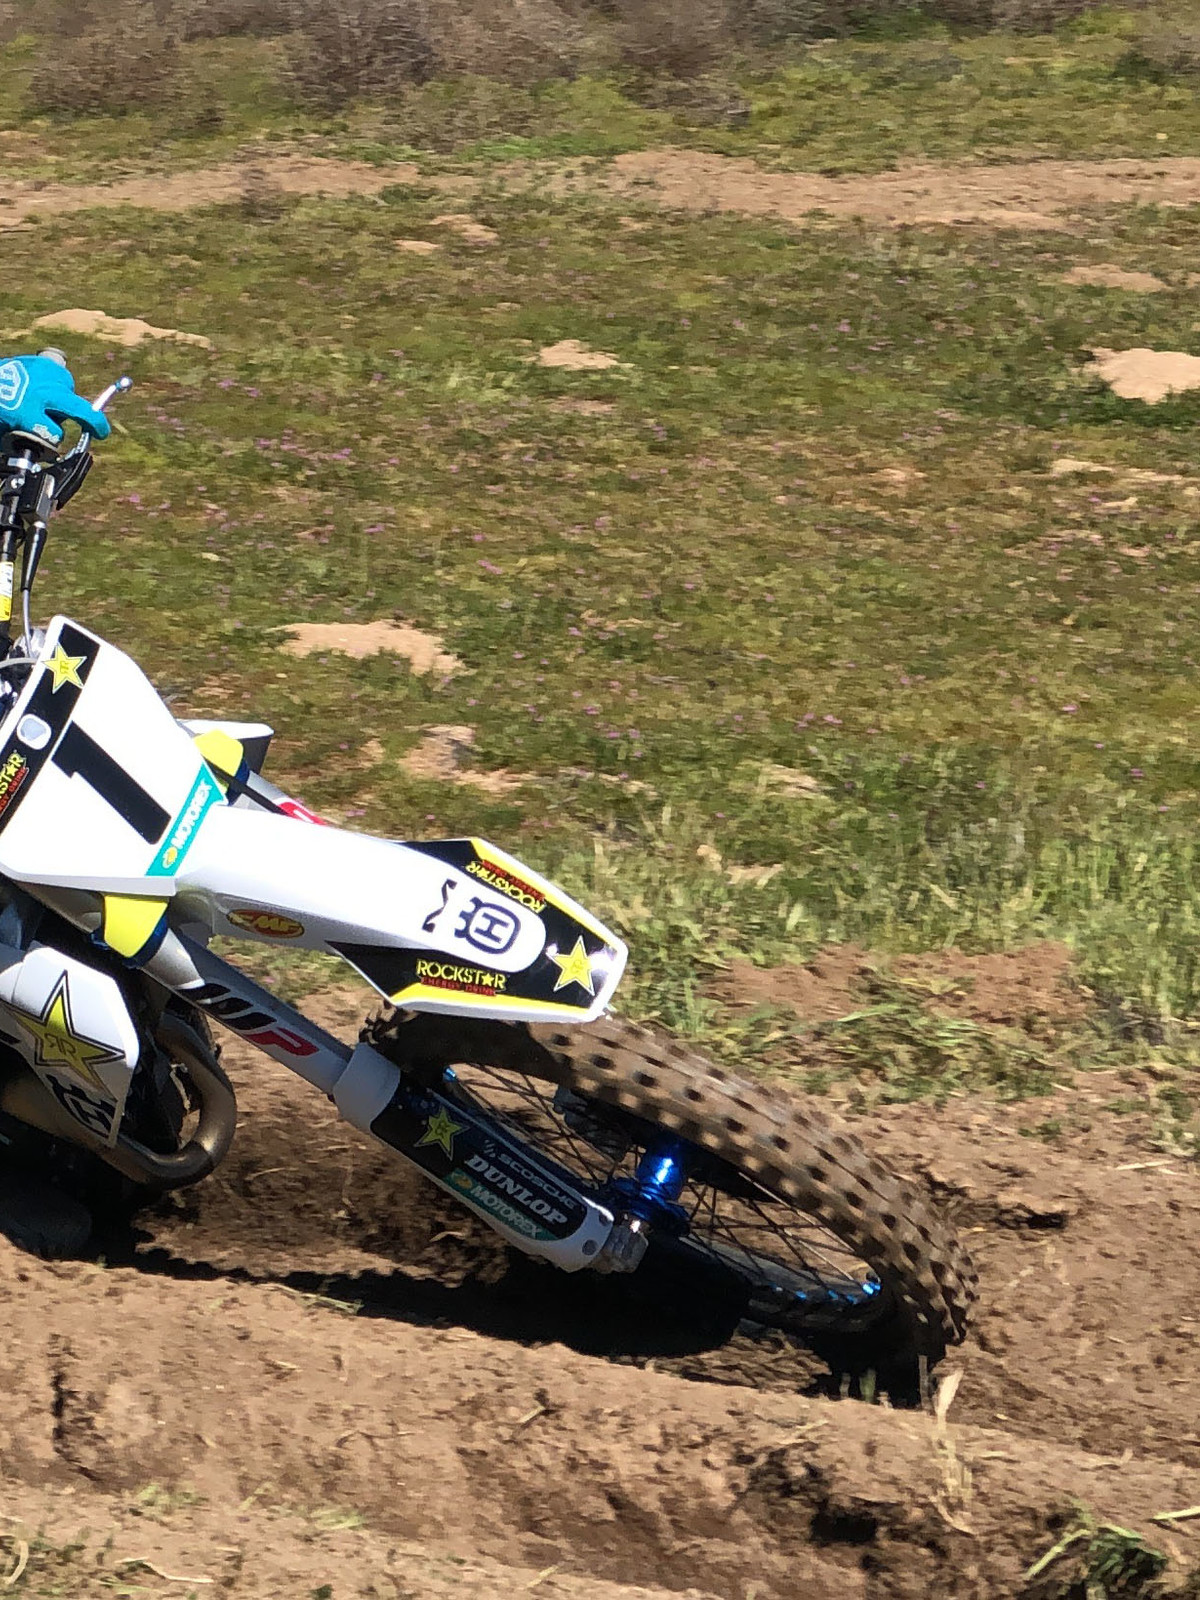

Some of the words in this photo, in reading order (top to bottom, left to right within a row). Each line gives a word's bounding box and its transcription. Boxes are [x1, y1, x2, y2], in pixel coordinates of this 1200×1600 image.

[51, 720, 171, 845] 1
[171, 780, 212, 850] MOTOREX
[465, 860, 547, 914] ROCKSTAR
[415, 958, 507, 989] ROCKSTAR
[463, 1154, 568, 1224] DUNLOP
[470, 1184, 543, 1237] MOTOREX
